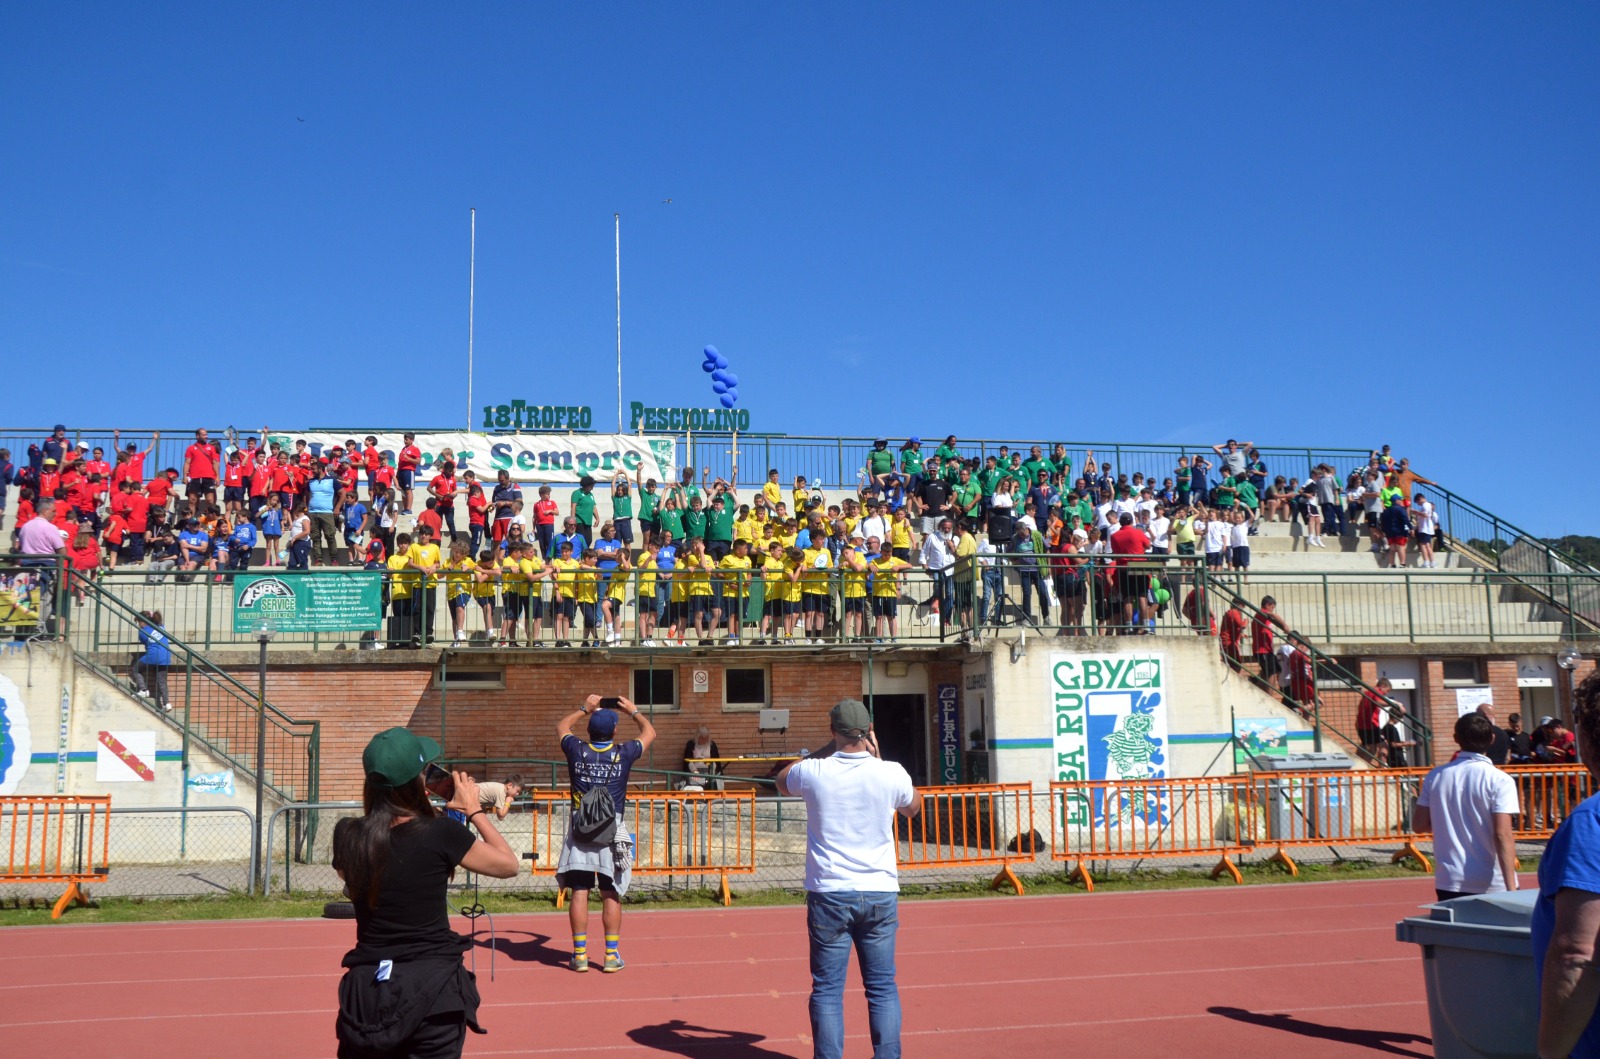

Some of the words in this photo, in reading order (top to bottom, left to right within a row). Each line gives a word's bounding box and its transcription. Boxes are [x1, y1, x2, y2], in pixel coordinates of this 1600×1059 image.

[630, 401, 749, 431] PESCIOLINO
[490, 442, 642, 478] Sempre
[261, 598, 296, 611] SERVICE
[943, 700, 957, 742] ELBA
[574, 761, 622, 771] GIOVANNI
